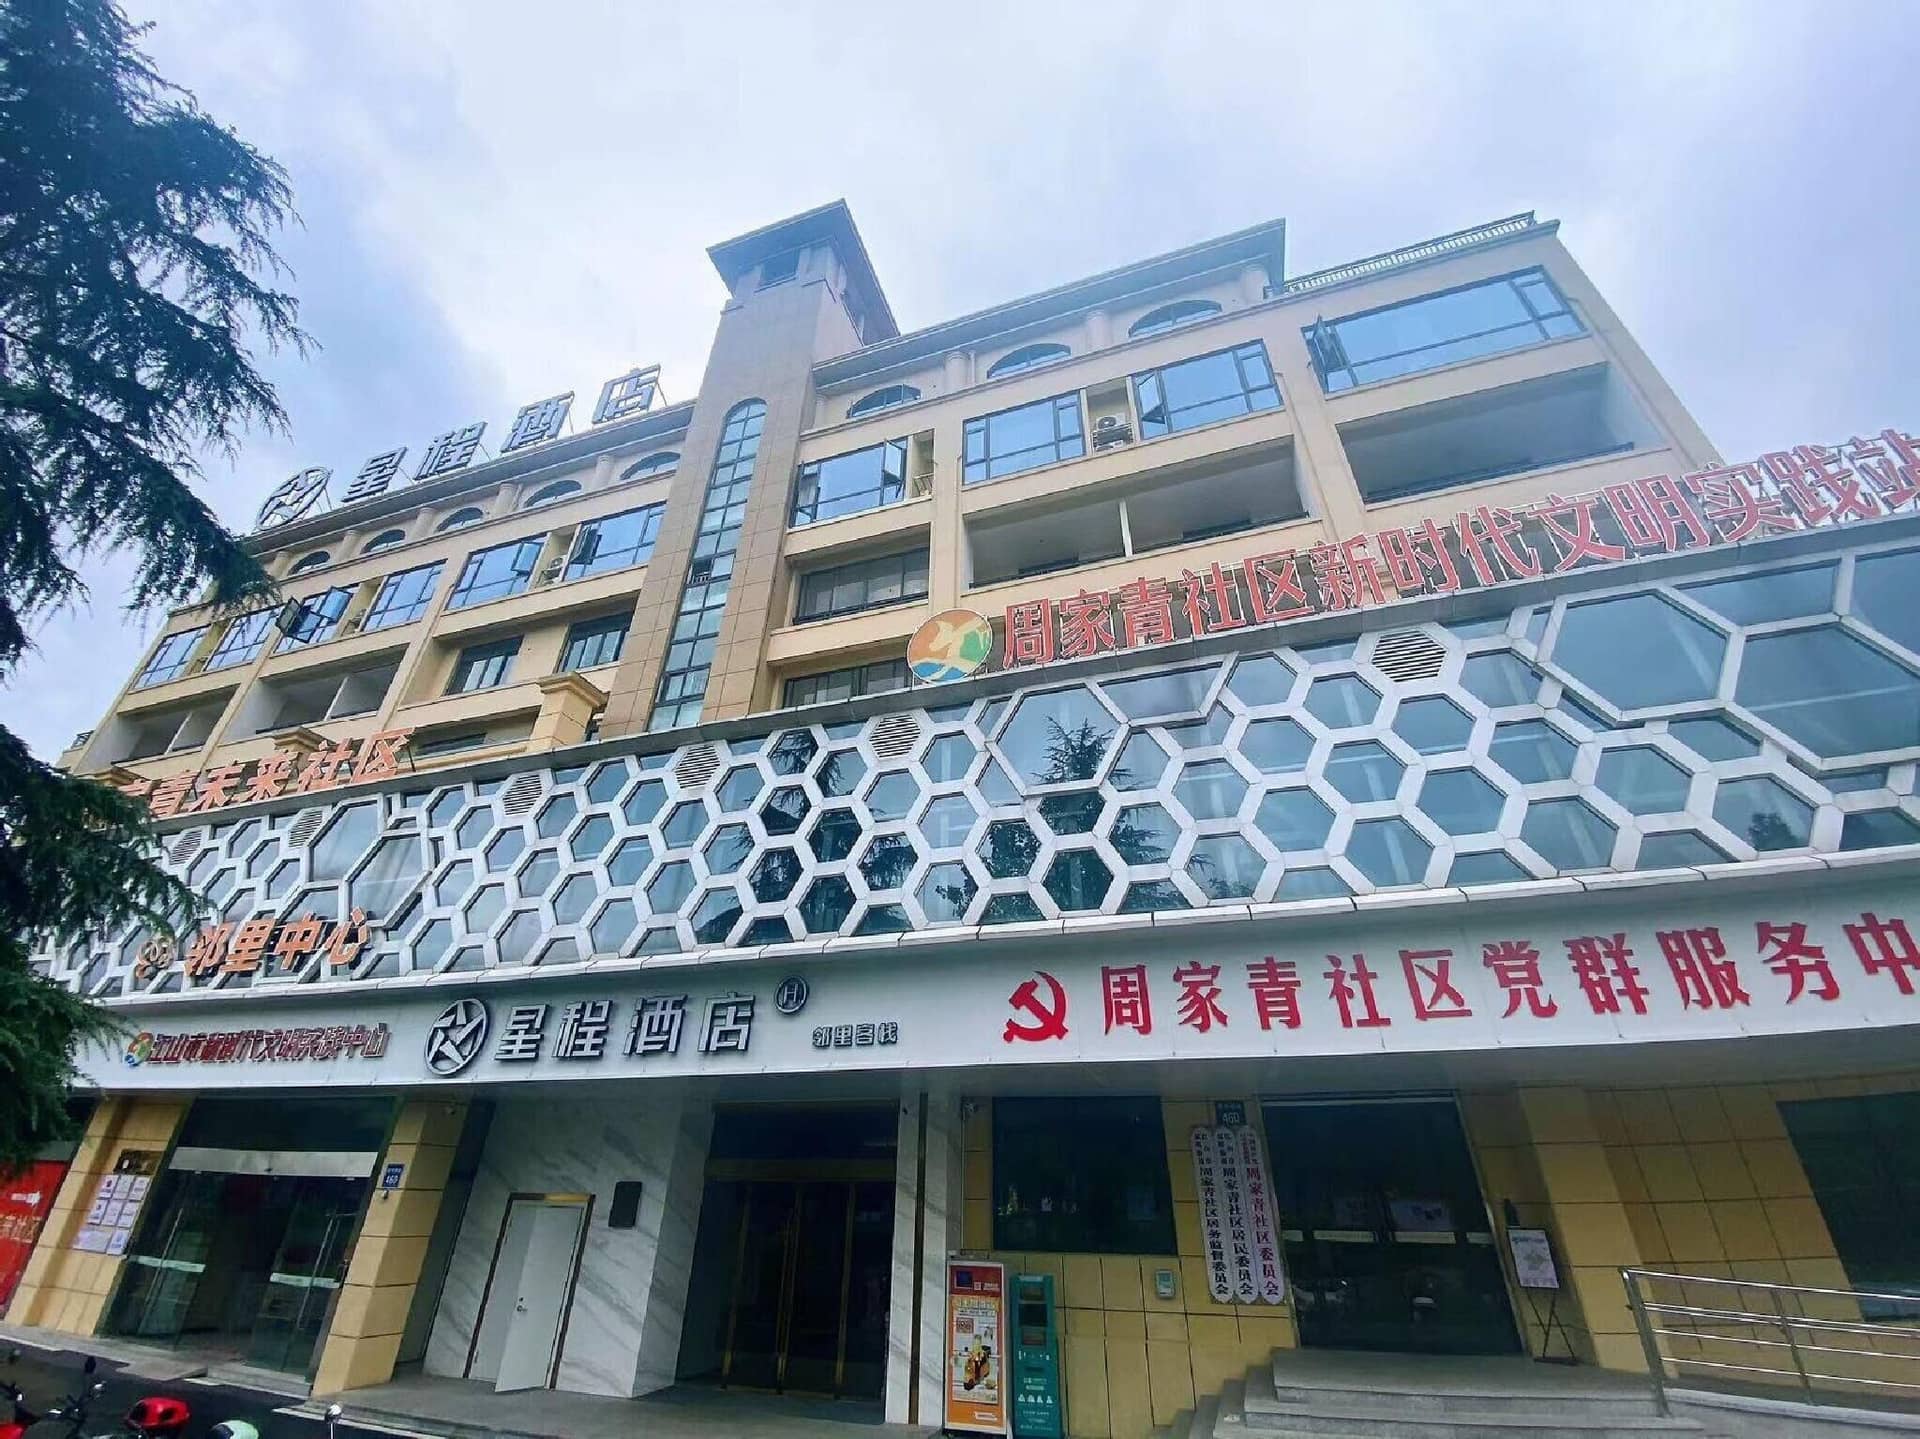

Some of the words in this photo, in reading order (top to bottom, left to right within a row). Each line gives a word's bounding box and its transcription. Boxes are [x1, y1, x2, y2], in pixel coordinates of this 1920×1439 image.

[342, 364, 660, 502] 星程酒店
[184, 906, 371, 976] 邻里中心
[494, 991, 757, 1061] 星程酒店
[812, 1021, 898, 1047] 邻里客栈
